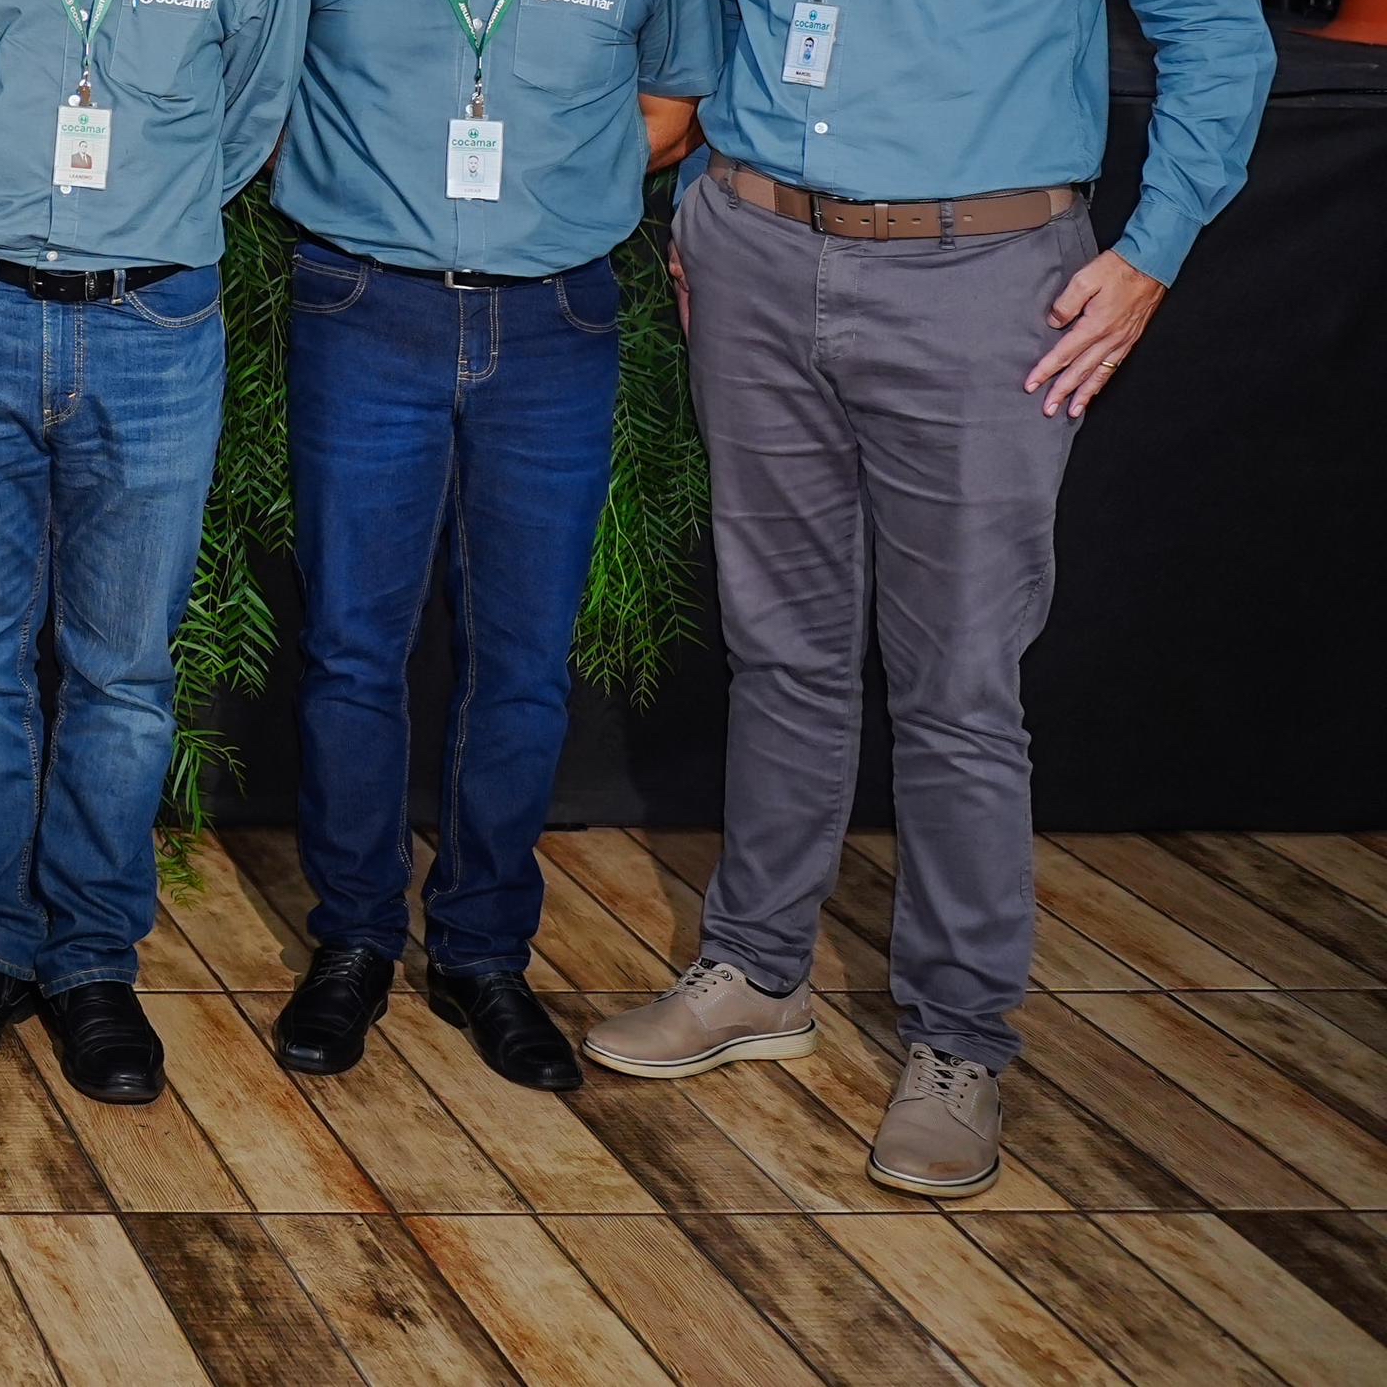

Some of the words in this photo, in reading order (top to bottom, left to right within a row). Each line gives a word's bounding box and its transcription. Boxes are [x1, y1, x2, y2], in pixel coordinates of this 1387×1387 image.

[795, 19, 830, 31] cocamar
[61, 124, 106, 134] cocamar
[452, 139, 497, 147] cocamar
